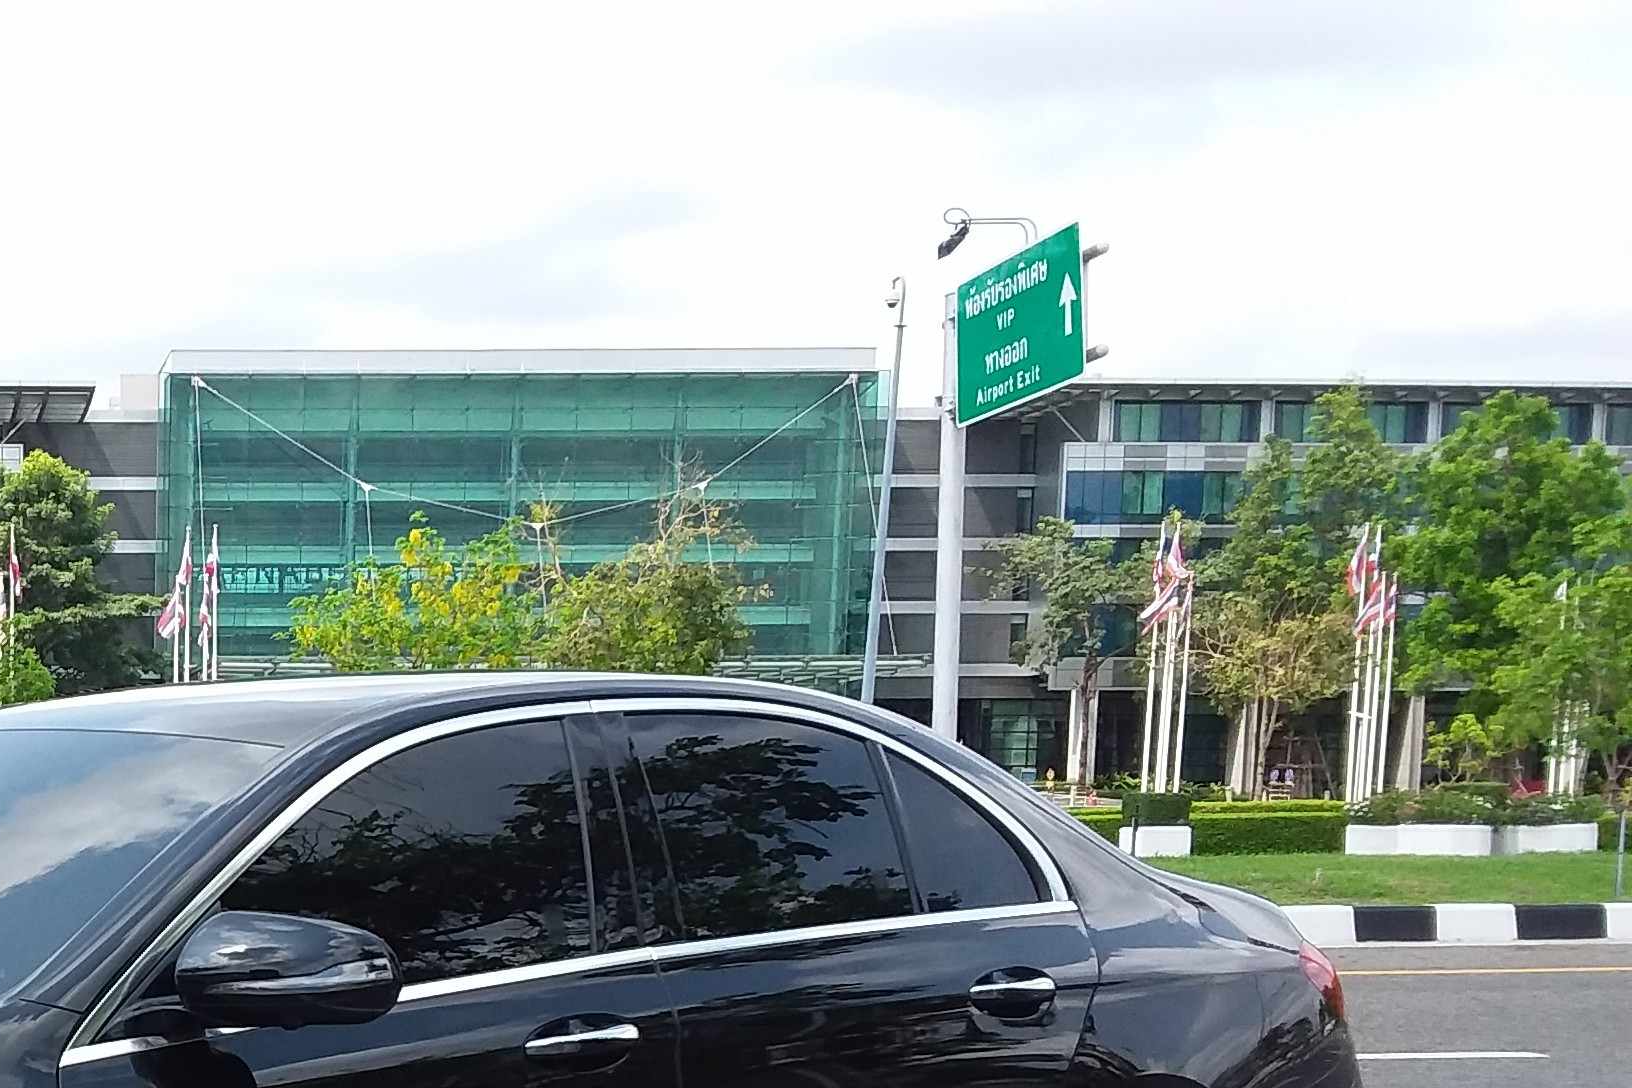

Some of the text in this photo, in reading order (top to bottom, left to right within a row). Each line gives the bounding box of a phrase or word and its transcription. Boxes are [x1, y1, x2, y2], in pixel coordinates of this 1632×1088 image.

[965, 258, 1048, 320] ห้องรับรองพิเศษ
[996, 307, 1015, 331] VIP
[984, 336, 1028, 375] ทางออก
[976, 364, 1041, 407] Airport Exit
